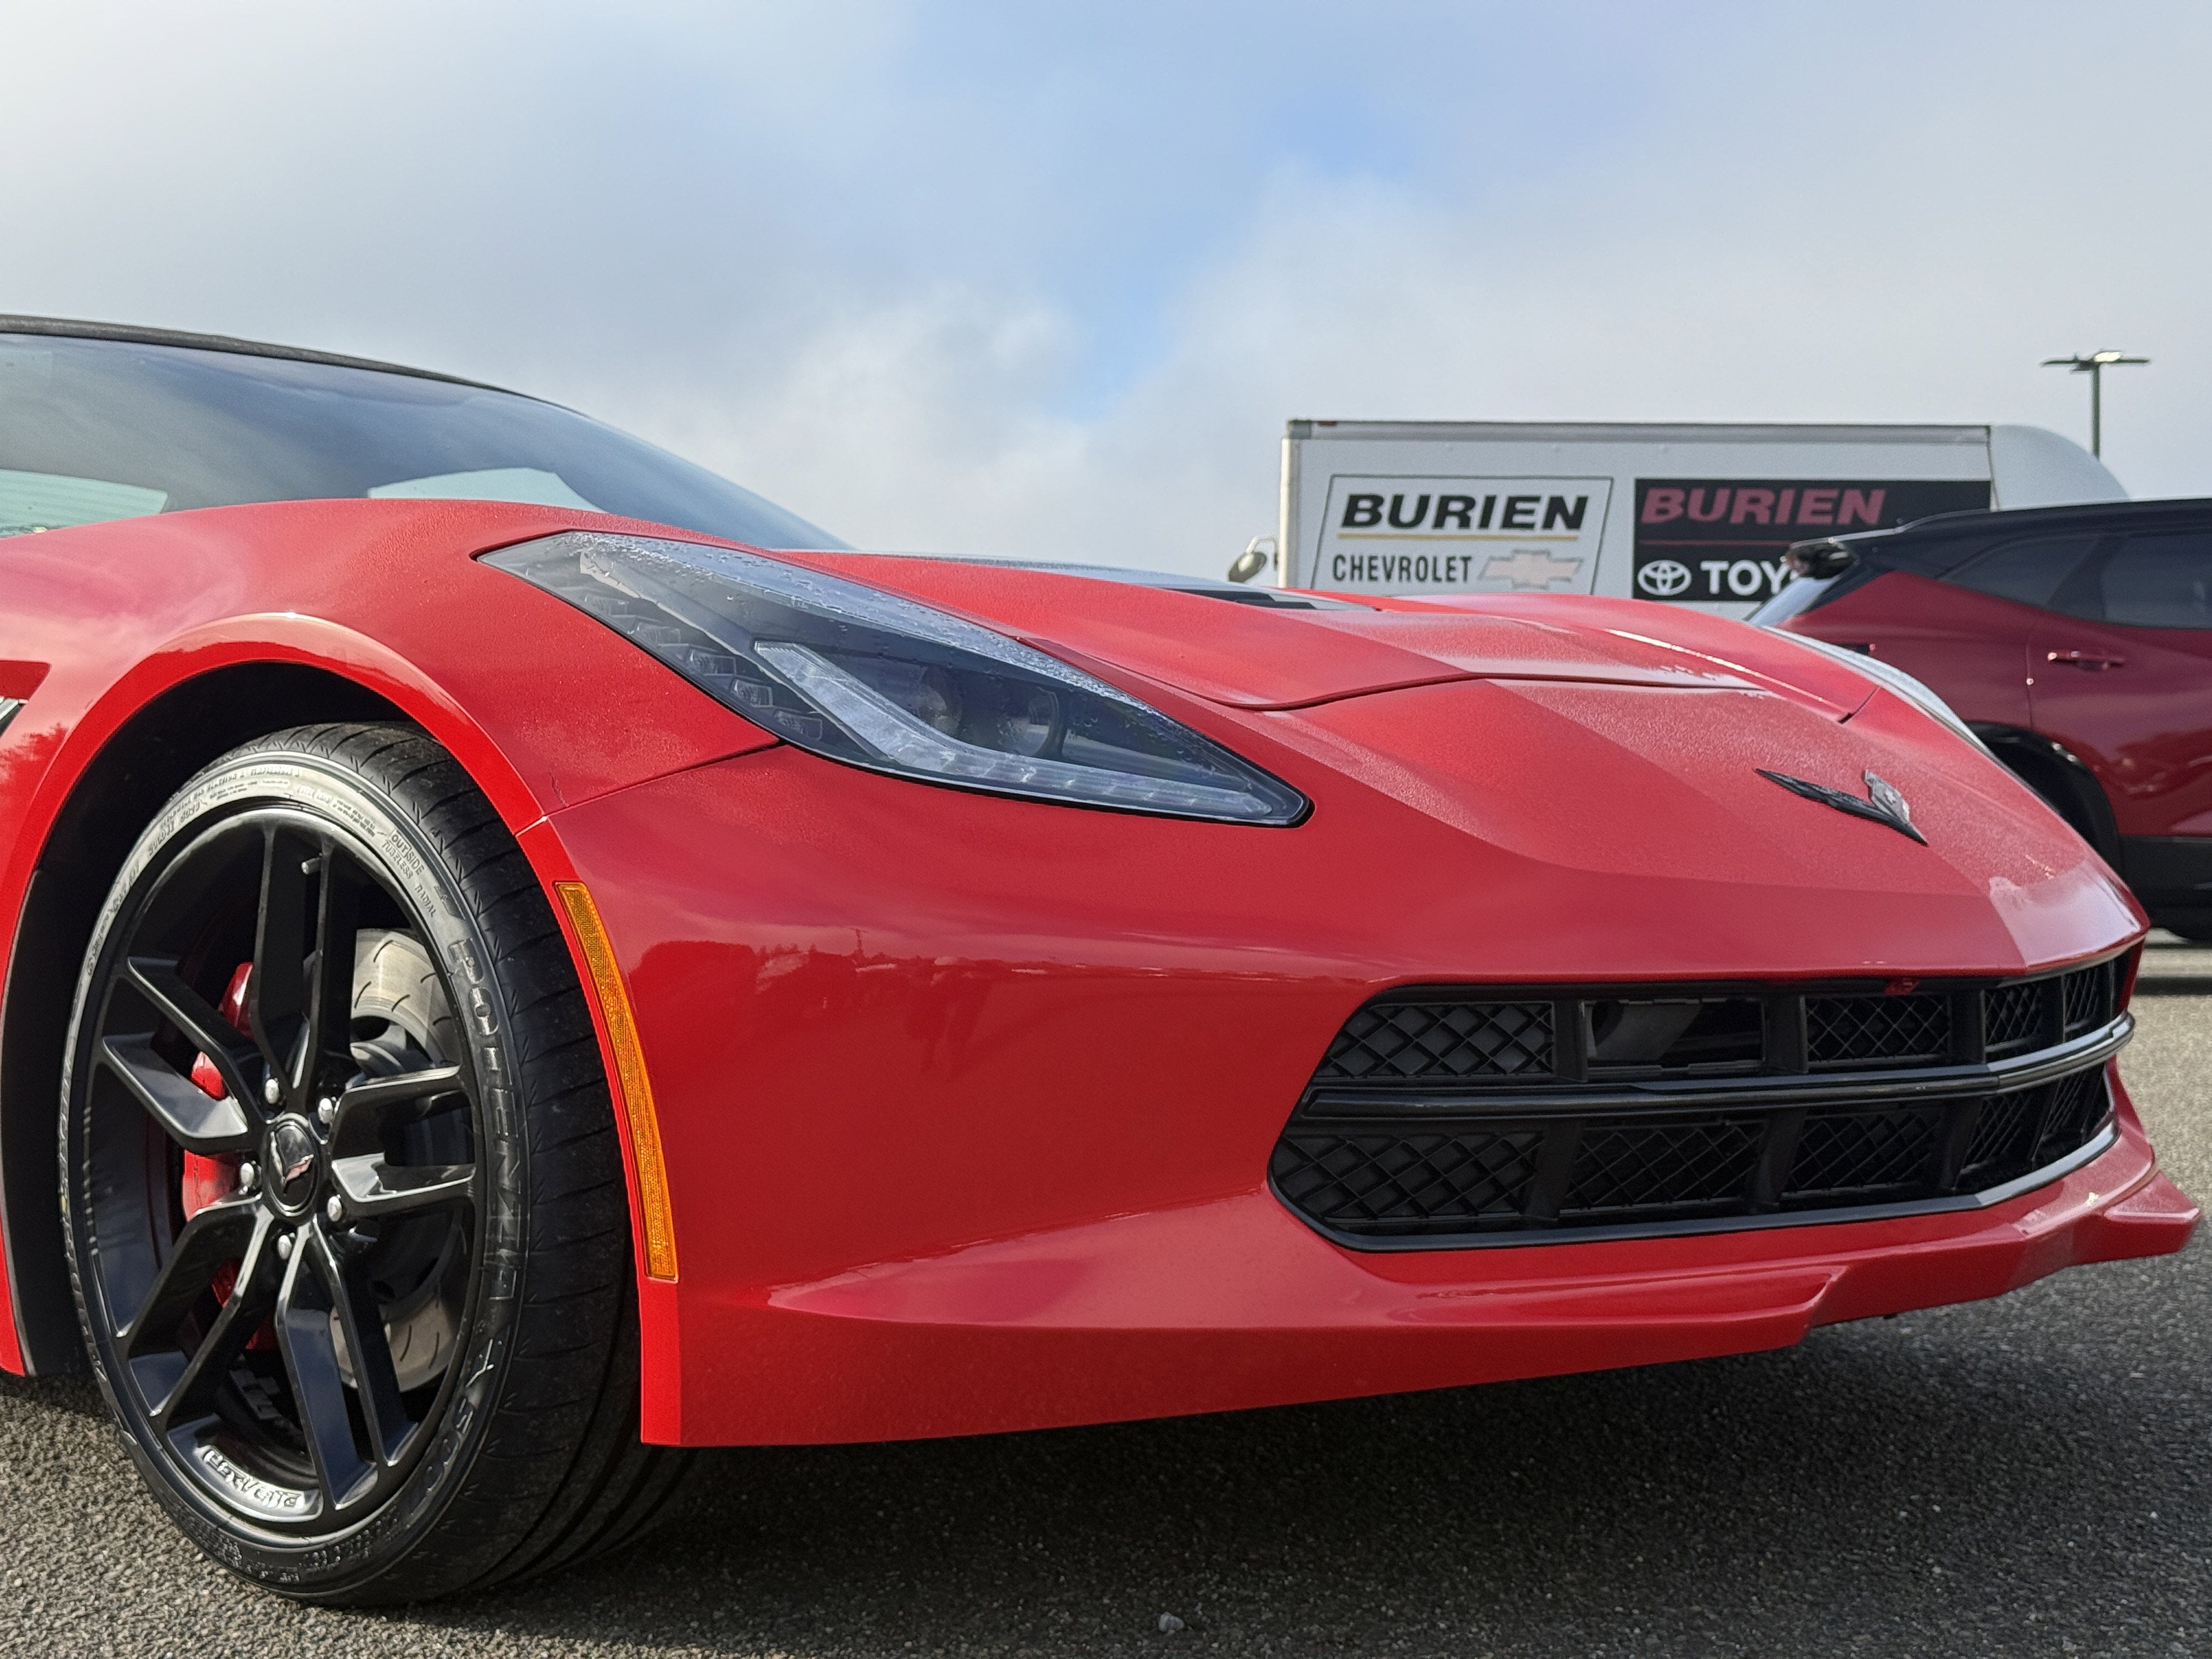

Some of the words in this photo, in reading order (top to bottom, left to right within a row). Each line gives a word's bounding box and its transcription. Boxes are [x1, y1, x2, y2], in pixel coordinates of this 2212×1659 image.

[1341, 493, 1589, 531] BURIEN
[1641, 488, 1886, 526] BURIEN
[1333, 554, 1472, 583] CHEVROLET
[1700, 559, 1798, 596] TOY
[415, 883, 436, 918] RADIAL
[447, 938, 520, 1299] POTENZA
